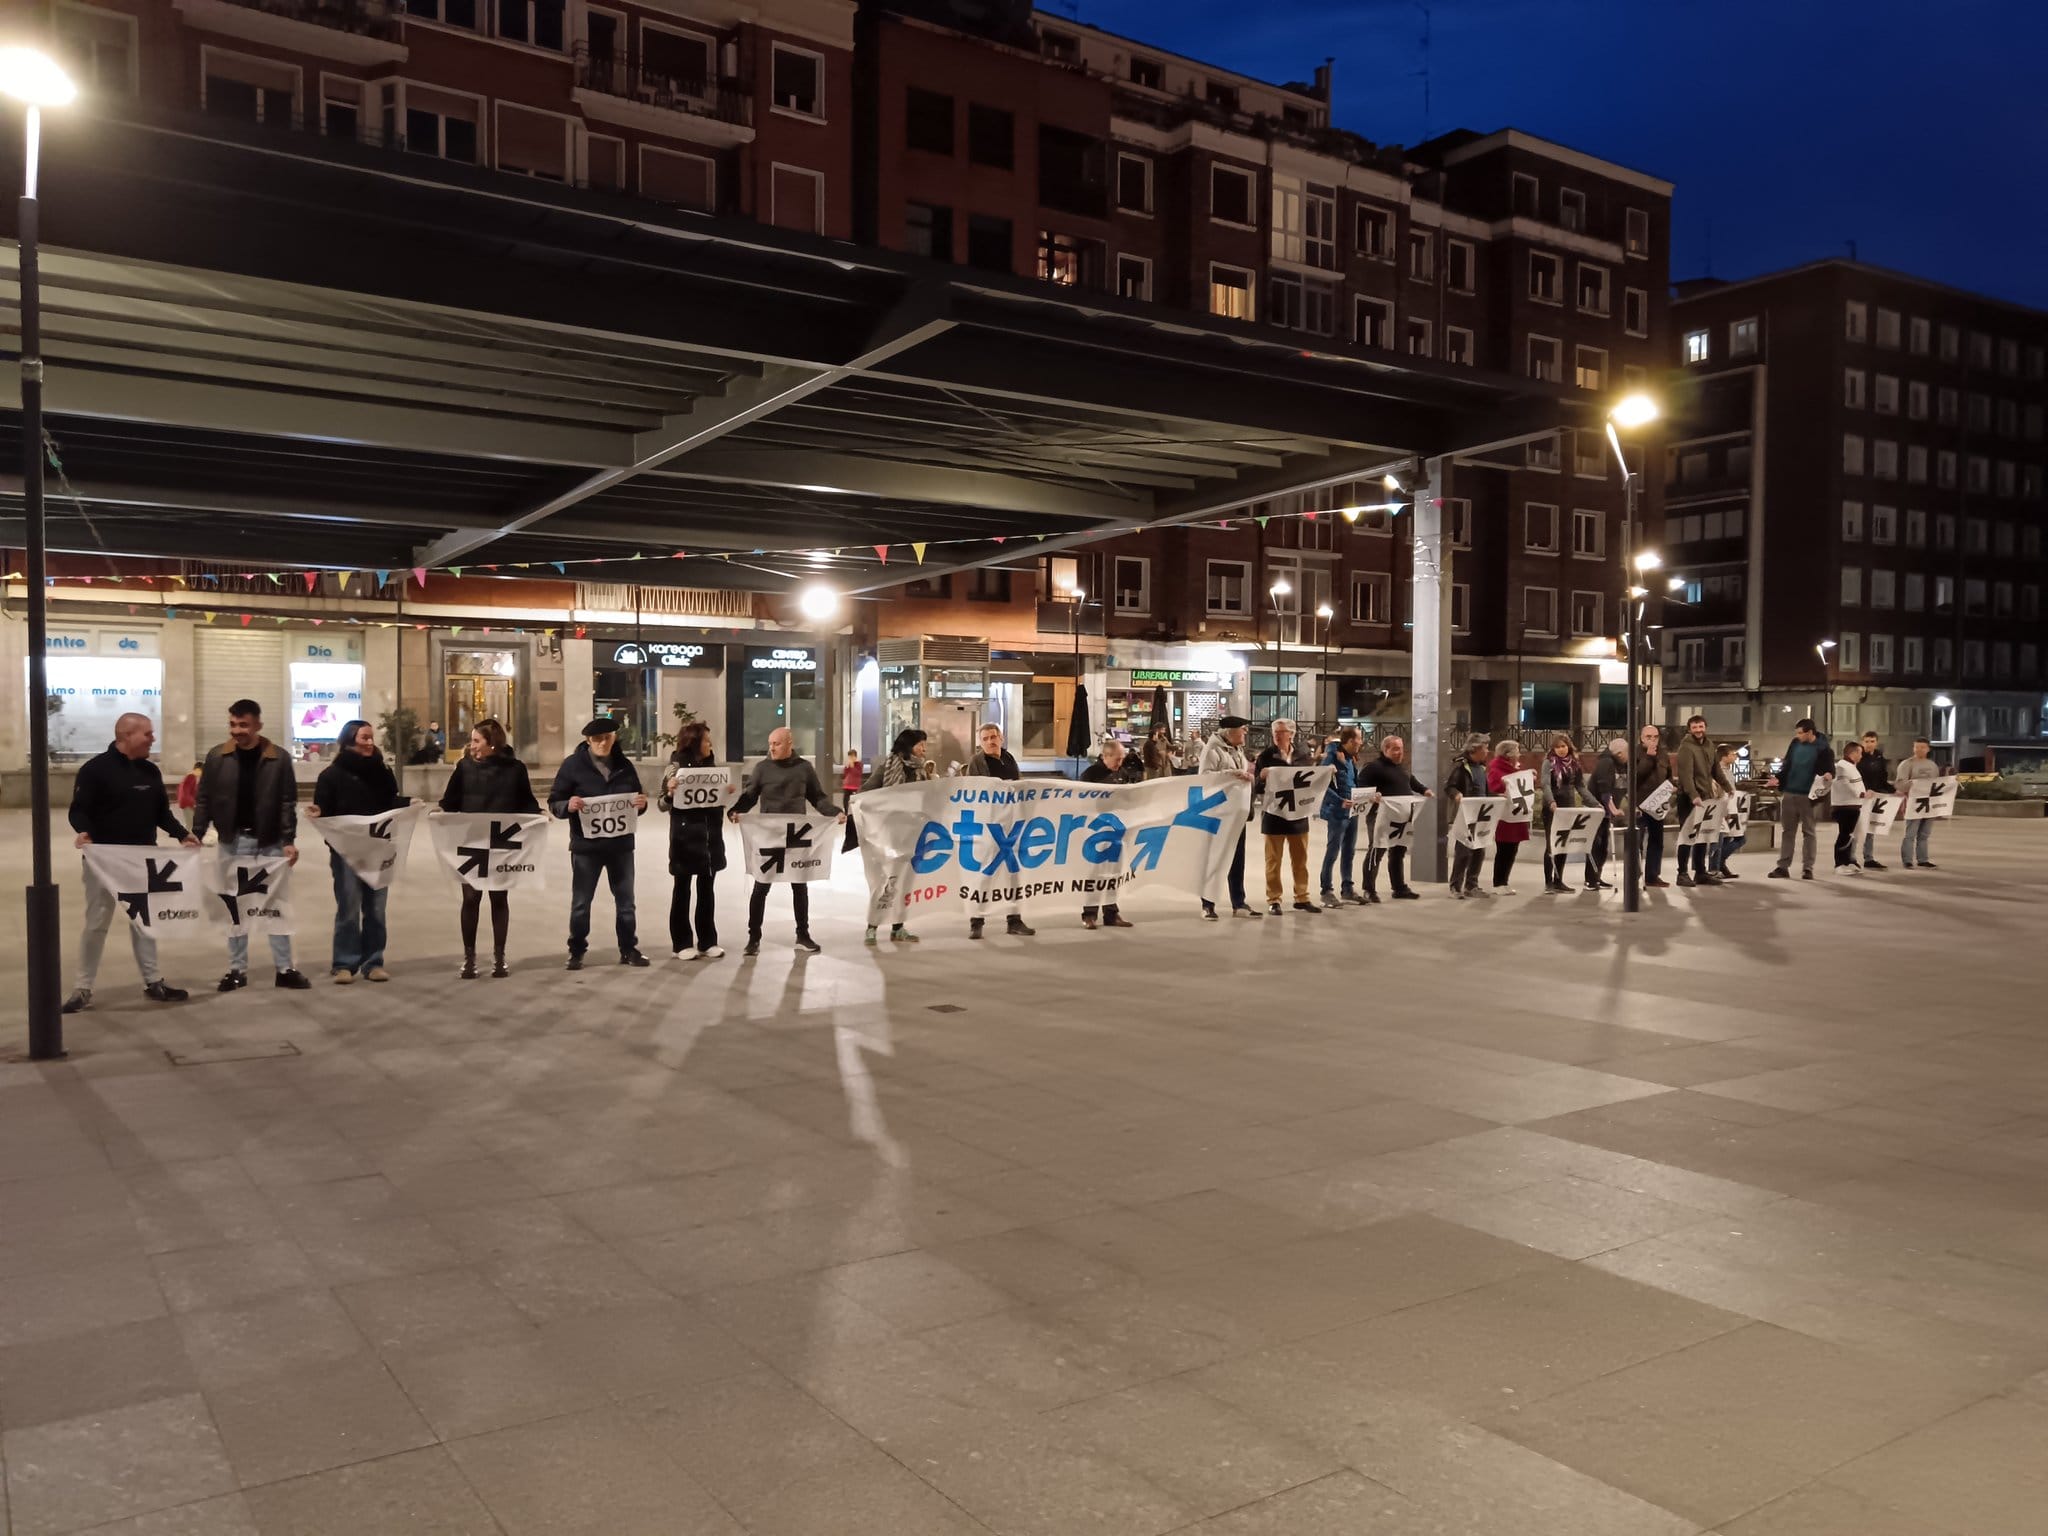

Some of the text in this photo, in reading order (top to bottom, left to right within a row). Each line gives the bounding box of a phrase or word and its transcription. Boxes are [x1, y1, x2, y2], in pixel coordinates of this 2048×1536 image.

[118, 638, 139, 649] de
[1169, 671, 1182, 680] DE
[92, 686, 127, 695] mimo
[303, 690, 335, 699] mimo
[678, 773, 729, 785] GOTZON
[683, 788, 719, 805] SOS
[950, 788, 1113, 804] JUANKAR ETA JON
[591, 815, 626, 834] SOS
[911, 809, 1126, 876] etxera
[496, 863, 535, 872] etxera
[904, 885, 948, 907] STOP
[959, 880, 1064, 903] SALBUESPEN
[158, 908, 199, 920] etxera
